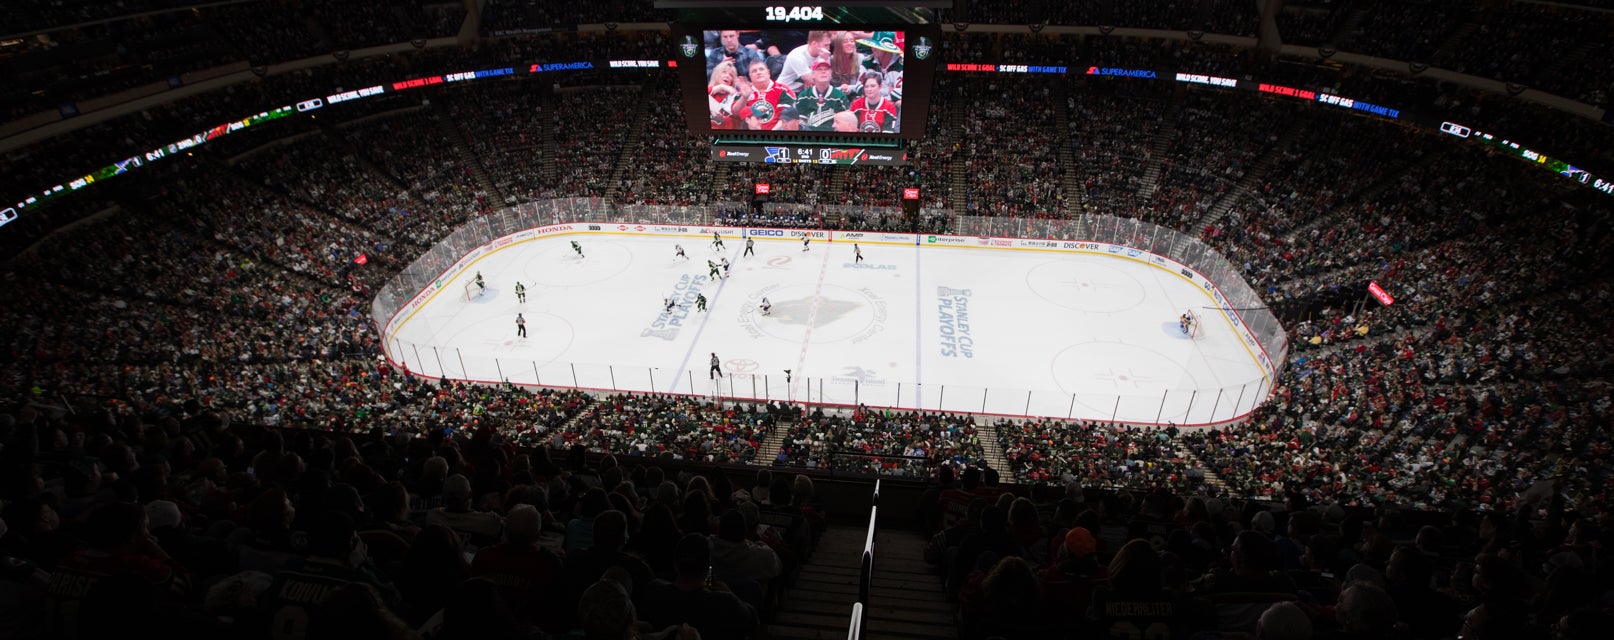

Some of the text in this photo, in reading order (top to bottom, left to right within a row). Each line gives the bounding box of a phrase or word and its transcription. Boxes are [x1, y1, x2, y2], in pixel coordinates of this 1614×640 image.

[765, 6, 824, 22] 19,404
[544, 62, 594, 71] SUPERAMERICA
[1101, 68, 1156, 78] SUPERAMERICA
[146, 148, 165, 161] 6:41
[781, 150, 786, 158] 1
[822, 150, 829, 158] 0
[1594, 178, 1614, 194] 6:41
[538, 225, 573, 234] HONDA
[411, 287, 435, 308] HONDA
[669, 274, 708, 327] PLAYOFFS
[938, 298, 958, 358] PLAYOFFS
[954, 296, 973, 358] STANLEY CUP
